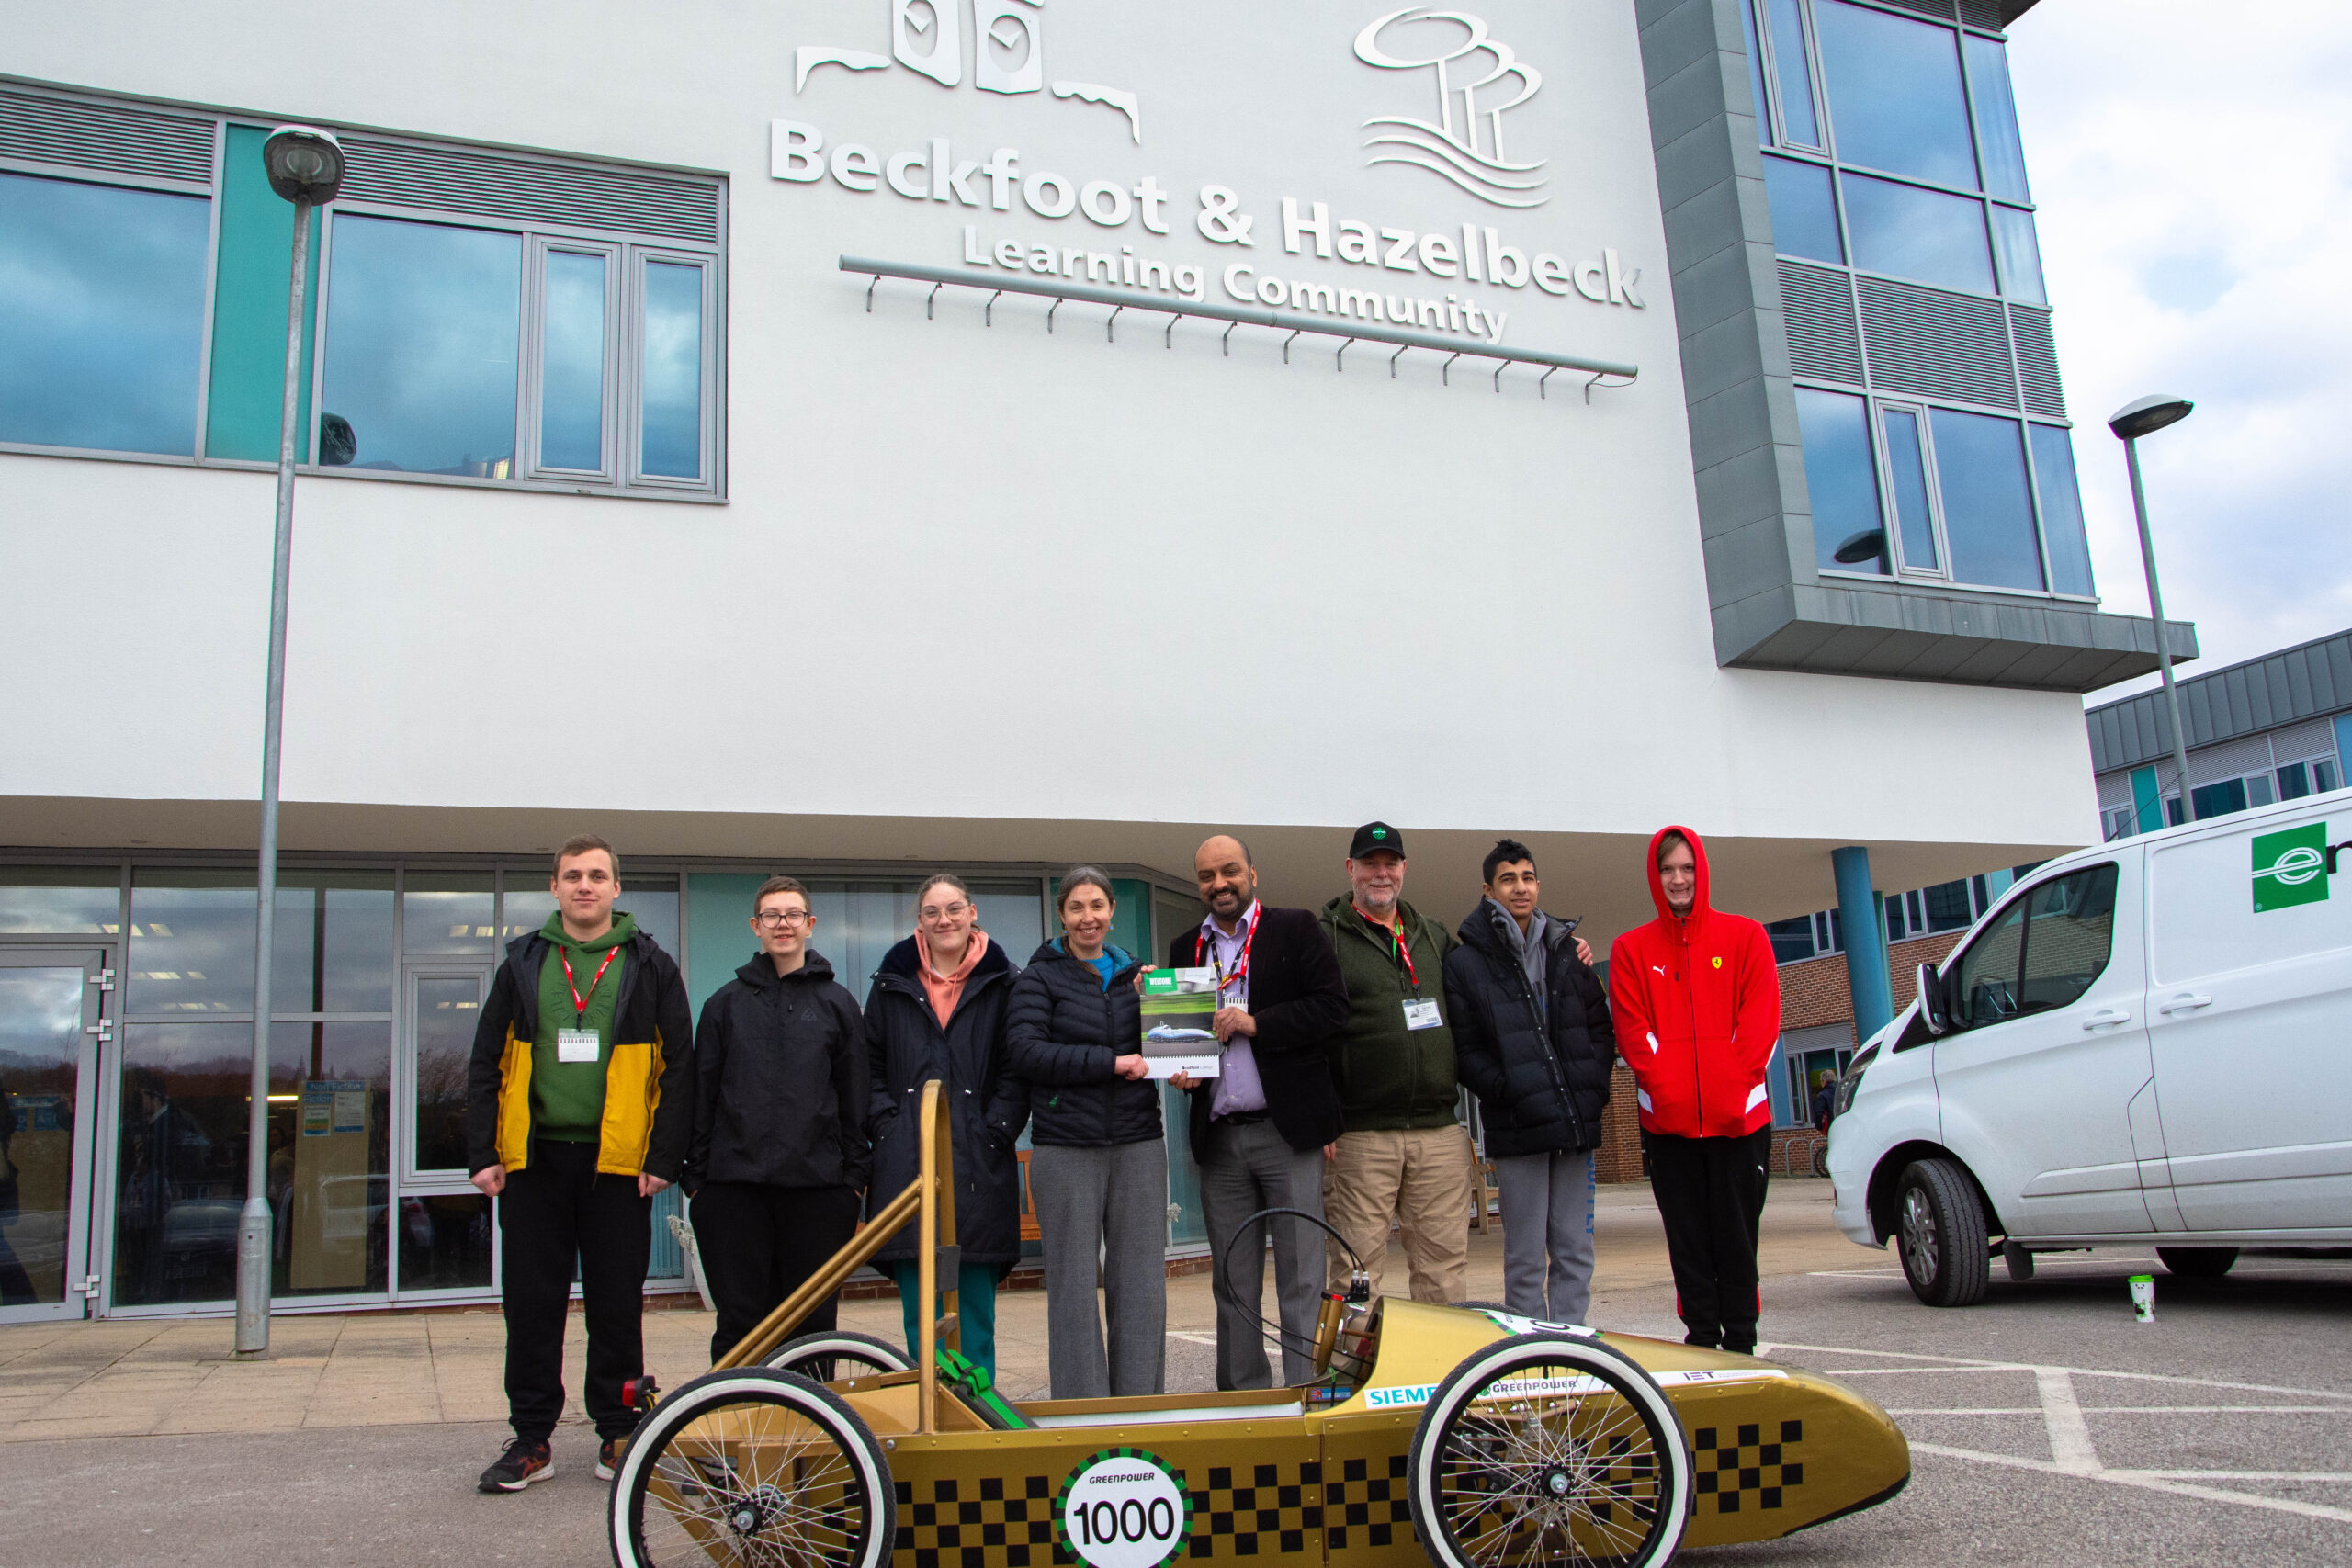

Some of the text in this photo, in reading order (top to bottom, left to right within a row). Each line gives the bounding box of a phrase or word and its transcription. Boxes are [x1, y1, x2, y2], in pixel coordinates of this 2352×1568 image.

[771, 118, 1646, 309] Beckfoot & Hazelbeck
[965, 225, 1507, 345] Learning Community
[1149, 977, 1172, 986] WELCOME
[303, 1094, 333, 1103] Fiction
[1683, 1371, 1714, 1381] IET
[1492, 1380, 1577, 1393] GREENPOWER
[1089, 1472, 1155, 1485] GREENPOWER
[1073, 1497, 1175, 1546] 1000
